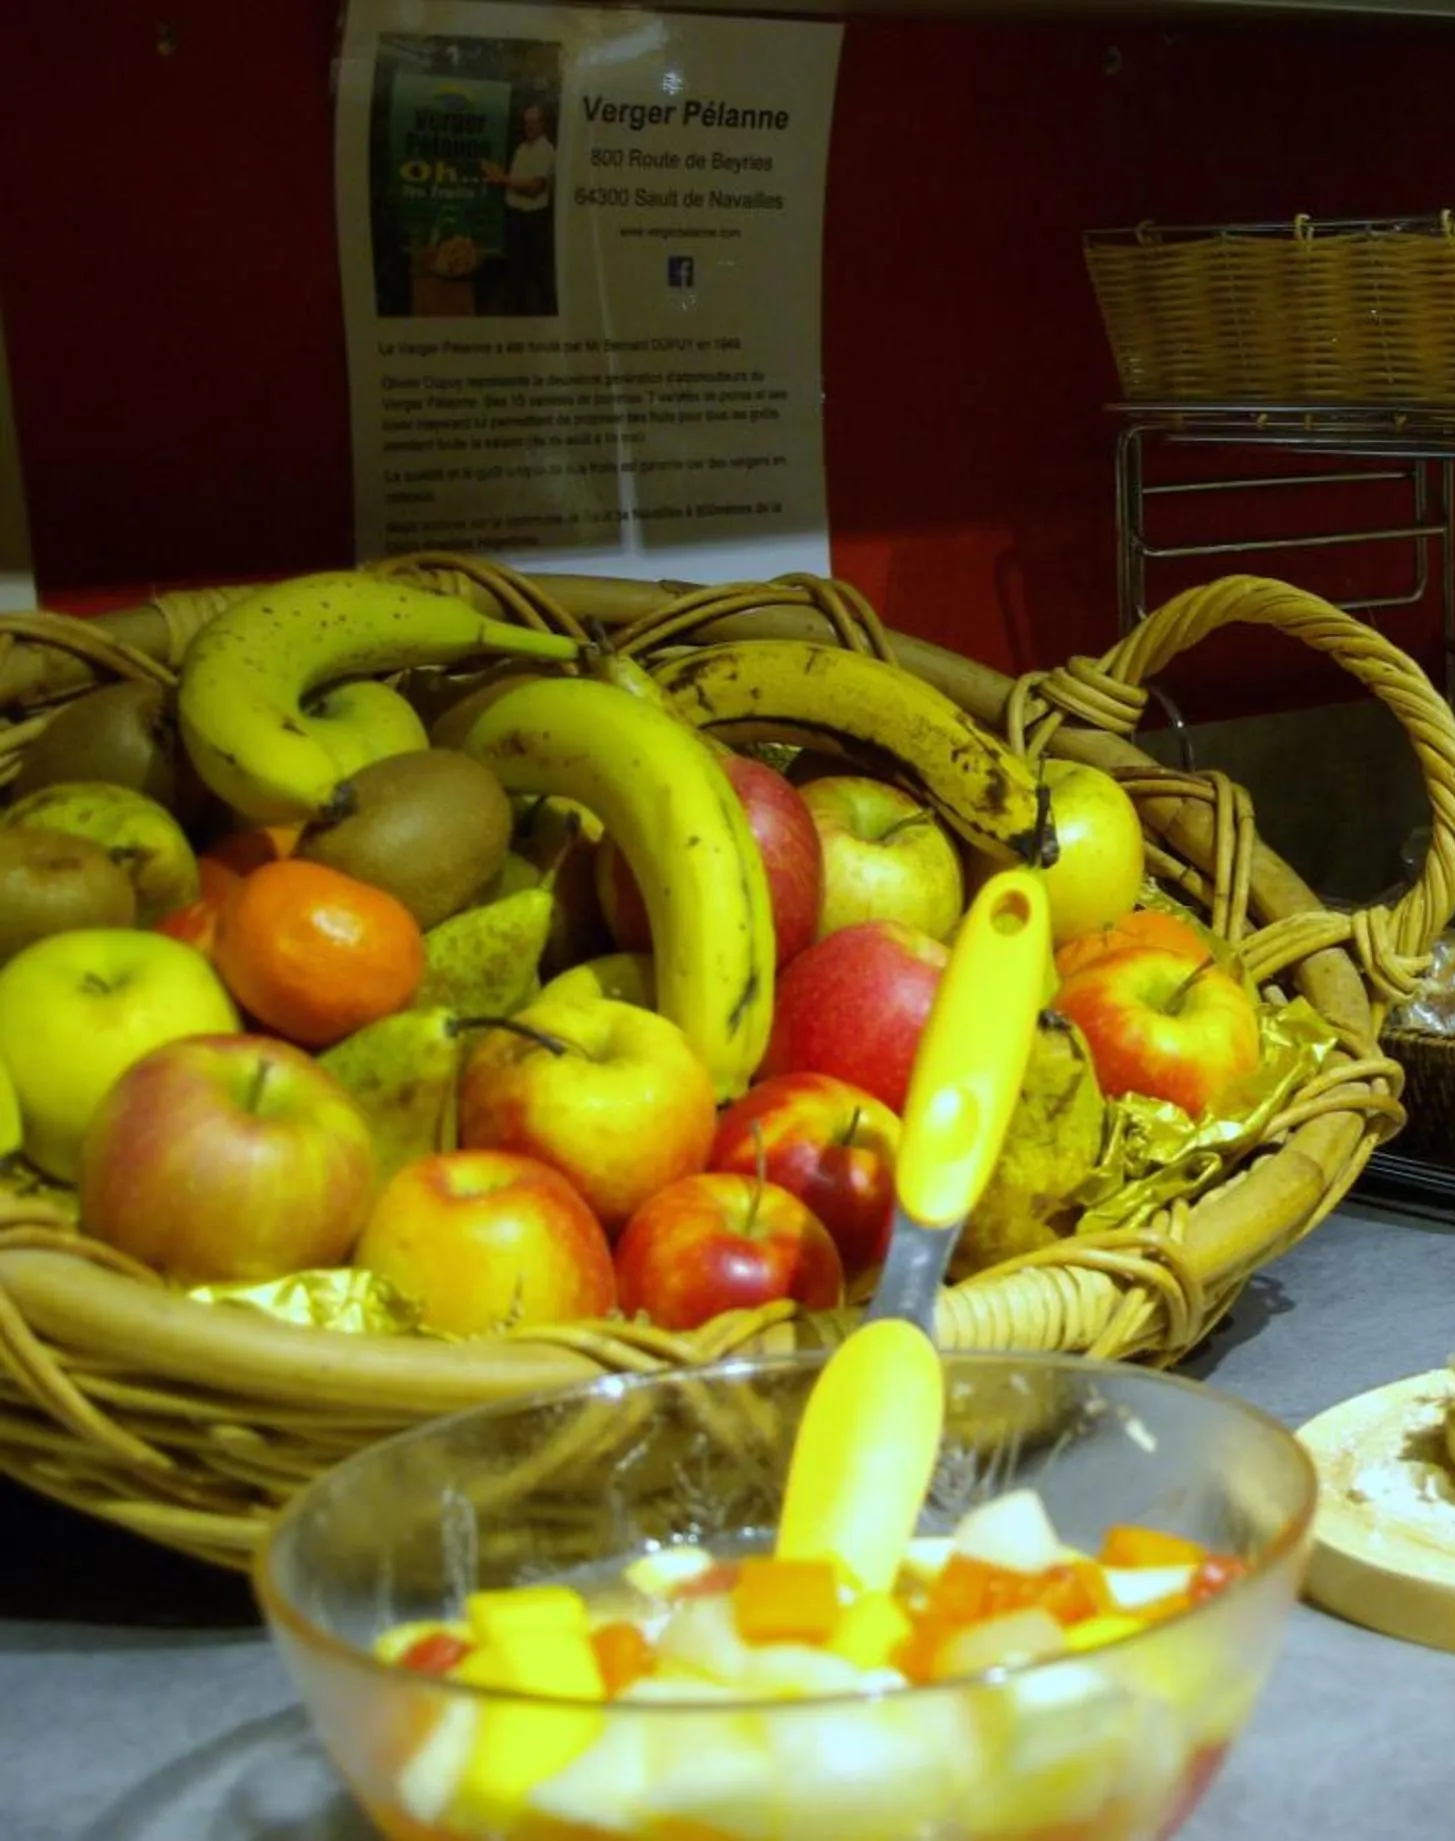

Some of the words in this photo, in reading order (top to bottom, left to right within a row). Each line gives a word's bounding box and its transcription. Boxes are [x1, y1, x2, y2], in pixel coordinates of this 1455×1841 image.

[583, 95, 676, 130] Verger
[682, 99, 790, 131] Pélanne
[590, 148, 623, 166] 800
[628, 149, 680, 169] Route
[684, 151, 706, 169] de
[711, 152, 773, 174] Beyries
[574, 188, 628, 206] 64300
[634, 188, 678, 207] Sault
[682, 189, 704, 207] de
[709, 190, 785, 210] Navailles
